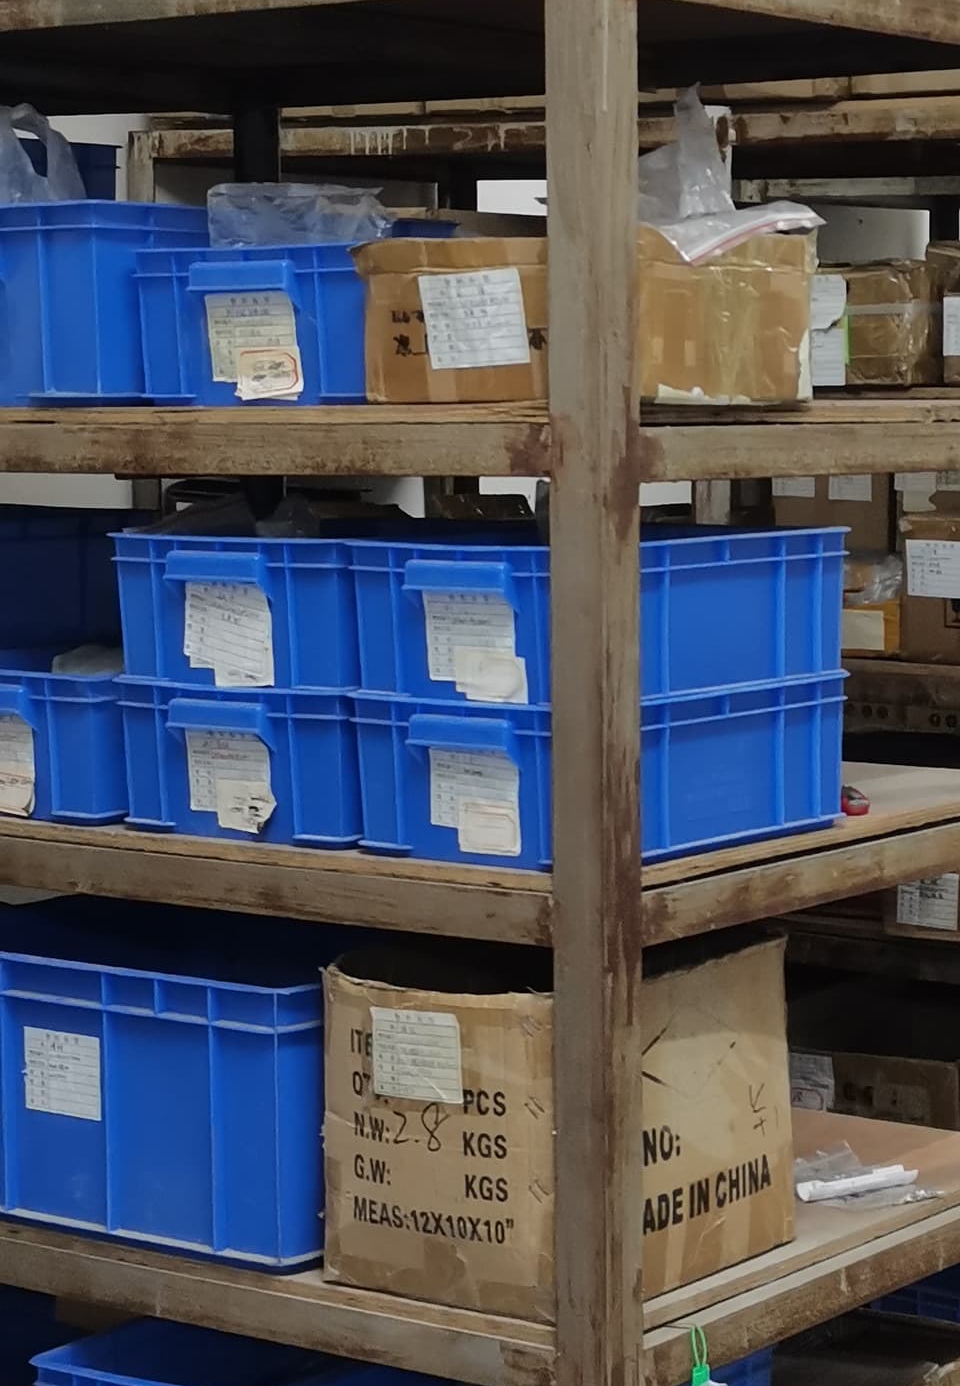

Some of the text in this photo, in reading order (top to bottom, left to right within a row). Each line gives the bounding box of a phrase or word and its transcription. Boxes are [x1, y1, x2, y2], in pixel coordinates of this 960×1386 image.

[351, 1028, 373, 1056] ITE
[393, 1102, 451, 1152] 2.8
[463, 1089, 507, 1117] PCS
[354, 1111, 508, 1159] N.W: KGS
[642, 1125, 681, 1166] NO:
[354, 1154, 509, 1202] G.W: KGS
[642, 1154, 772, 1236] ADE IN CHINA
